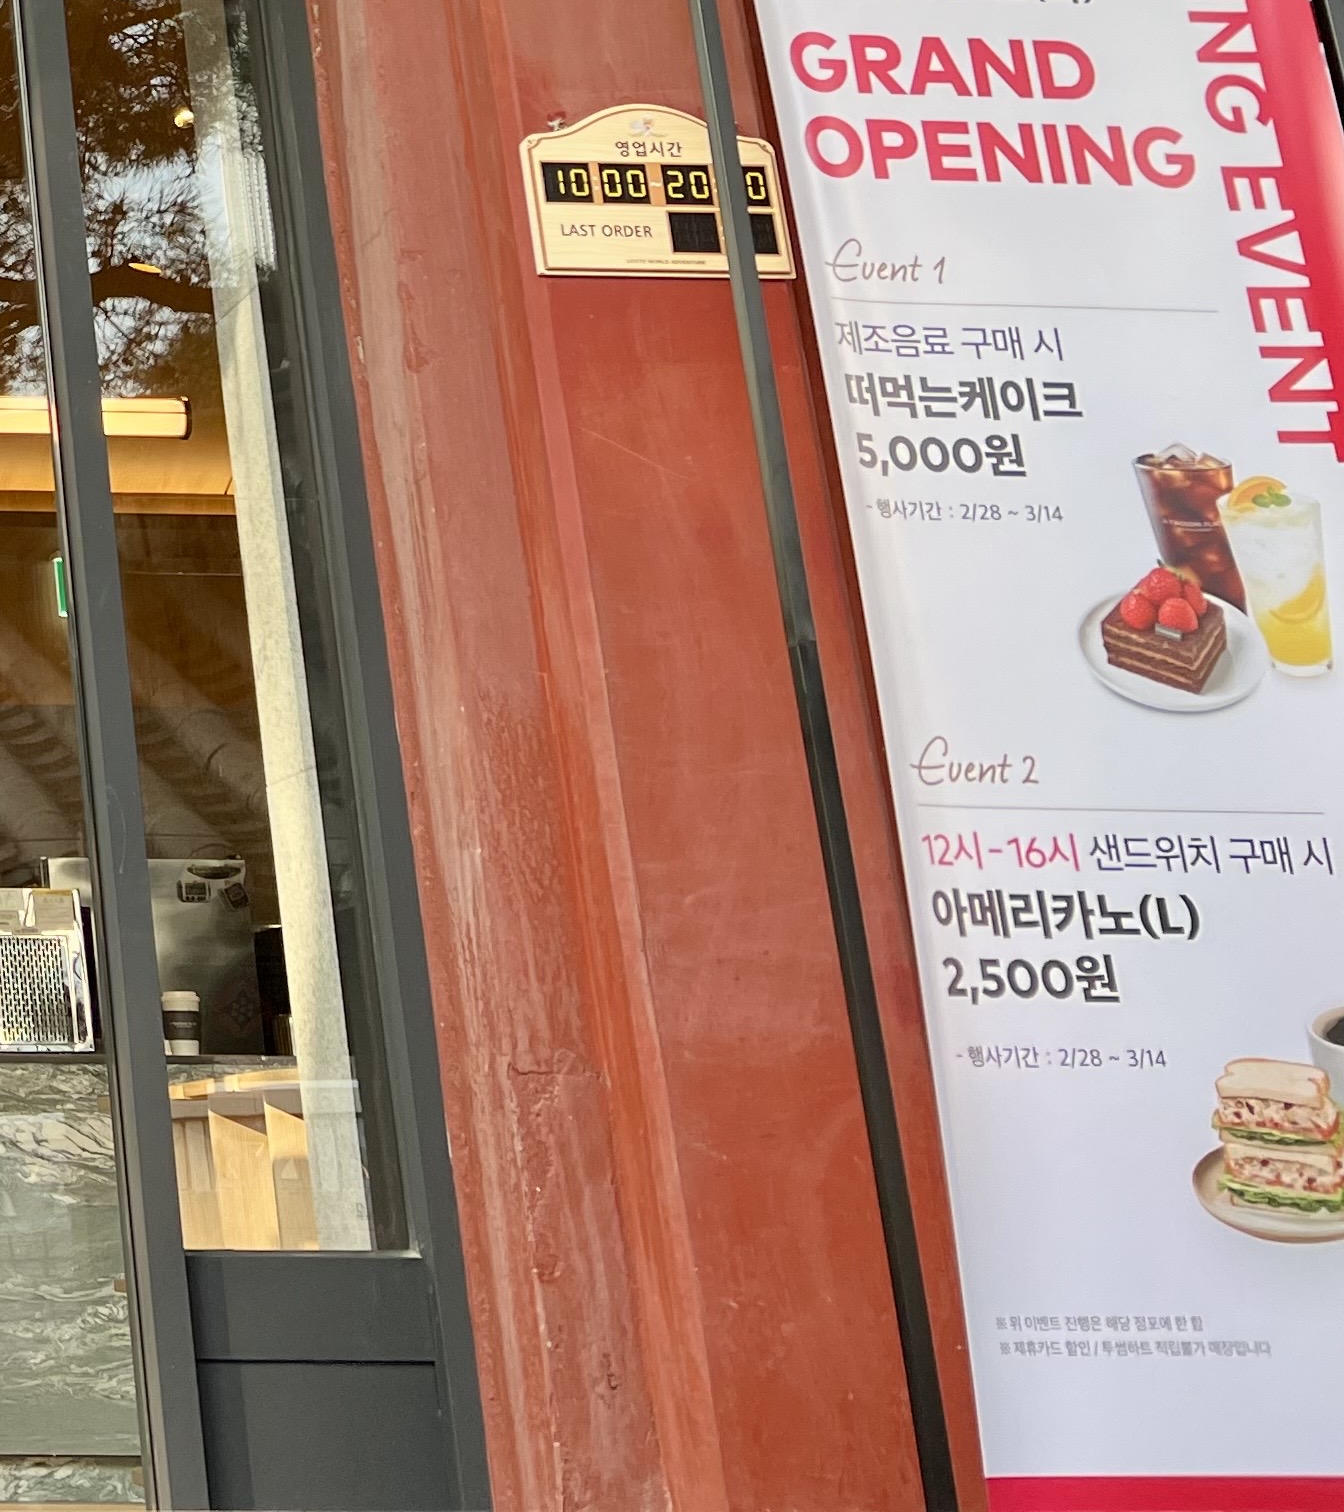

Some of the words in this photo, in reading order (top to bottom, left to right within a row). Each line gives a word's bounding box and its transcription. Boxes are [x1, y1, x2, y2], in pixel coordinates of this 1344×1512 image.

[790, 31, 1096, 100] GRAND
[615, 140, 683, 158] 영업시간
[805, 115, 1196, 189] OPENING
[557, 168, 647, 199] 10:00
[666, 170, 767, 201] 20:0
[561, 223, 596, 237] LAST
[601, 224, 653, 238] ORDER
[824, 237, 921, 285] Event
[932, 257, 946, 285] 1
[1221, 165, 1344, 464] EVENT
[835, 320, 954, 359] 제조음료
[961, 326, 1025, 360] 구매
[1033, 327, 1065, 362] 시
[844, 371, 1084, 423] 떠먹는케이크
[856, 432, 1027, 478] 5,000원
[876, 498, 943, 523] 행사기간
[960, 502, 1003, 524] 2/28
[1025, 502, 1064, 524] 3/14
[910, 735, 1013, 787] Event
[1021, 756, 1040, 786] 2
[922, 831, 1082, 873] 12시-16시
[1089, 834, 1221, 875] 샌드위치
[1229, 836, 1294, 876] 구매
[1303, 837, 1335, 877] 시
[932, 888, 1201, 942] 아메리카노(L)
[942, 952, 1121, 1006] 2,500원
[968, 1044, 1039, 1070] 행사기간
[1059, 1048, 1102, 1071] 2/28
[1127, 1048, 1167, 1070] 3/14
[1024, 1316, 1061, 1332] 이벤트
[1013, 1341, 1061, 1357] 제휴카드
